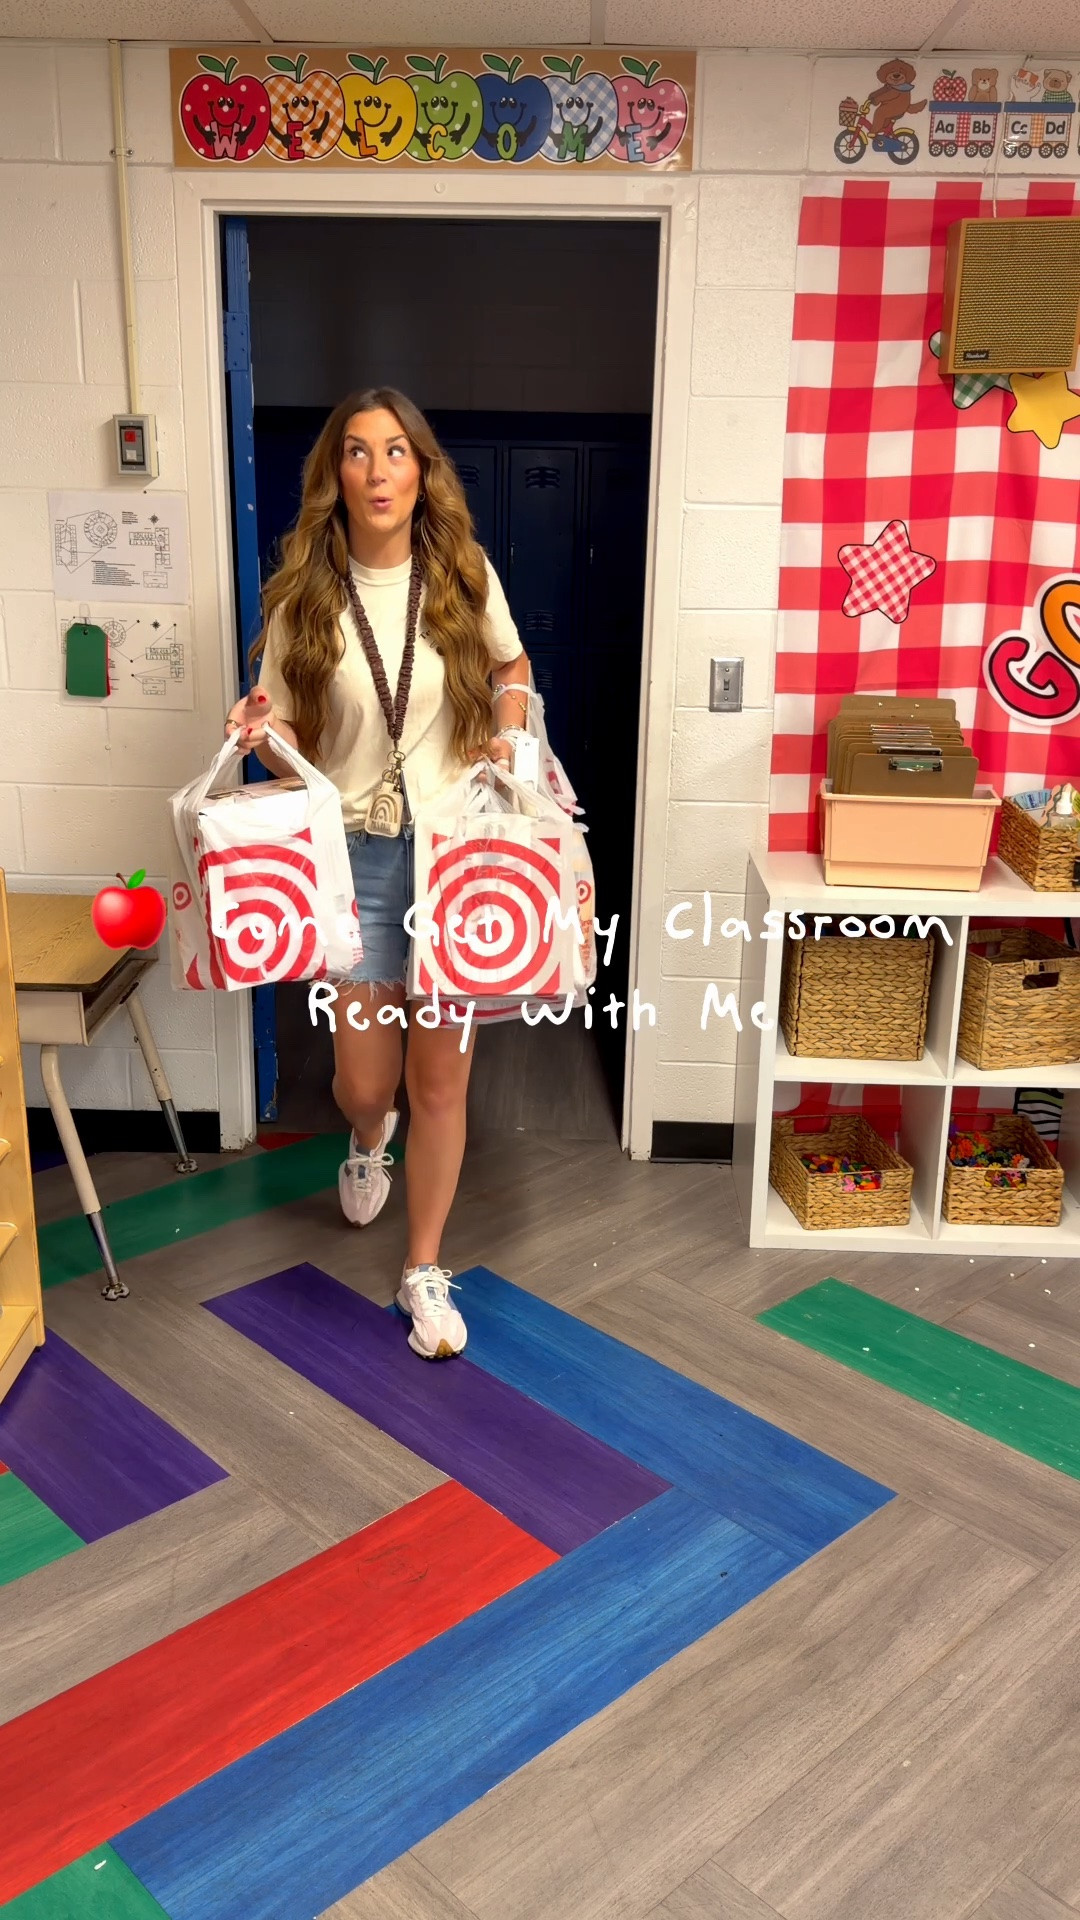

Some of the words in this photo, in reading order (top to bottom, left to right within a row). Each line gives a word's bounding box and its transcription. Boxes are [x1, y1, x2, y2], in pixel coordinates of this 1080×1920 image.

[935, 120, 955, 134] Aa
[972, 120, 991, 134] Bb
[1010, 120, 1028, 135] Cc
[1045, 120, 1066, 135] Dd
[210, 119, 646, 162] WELCOME
